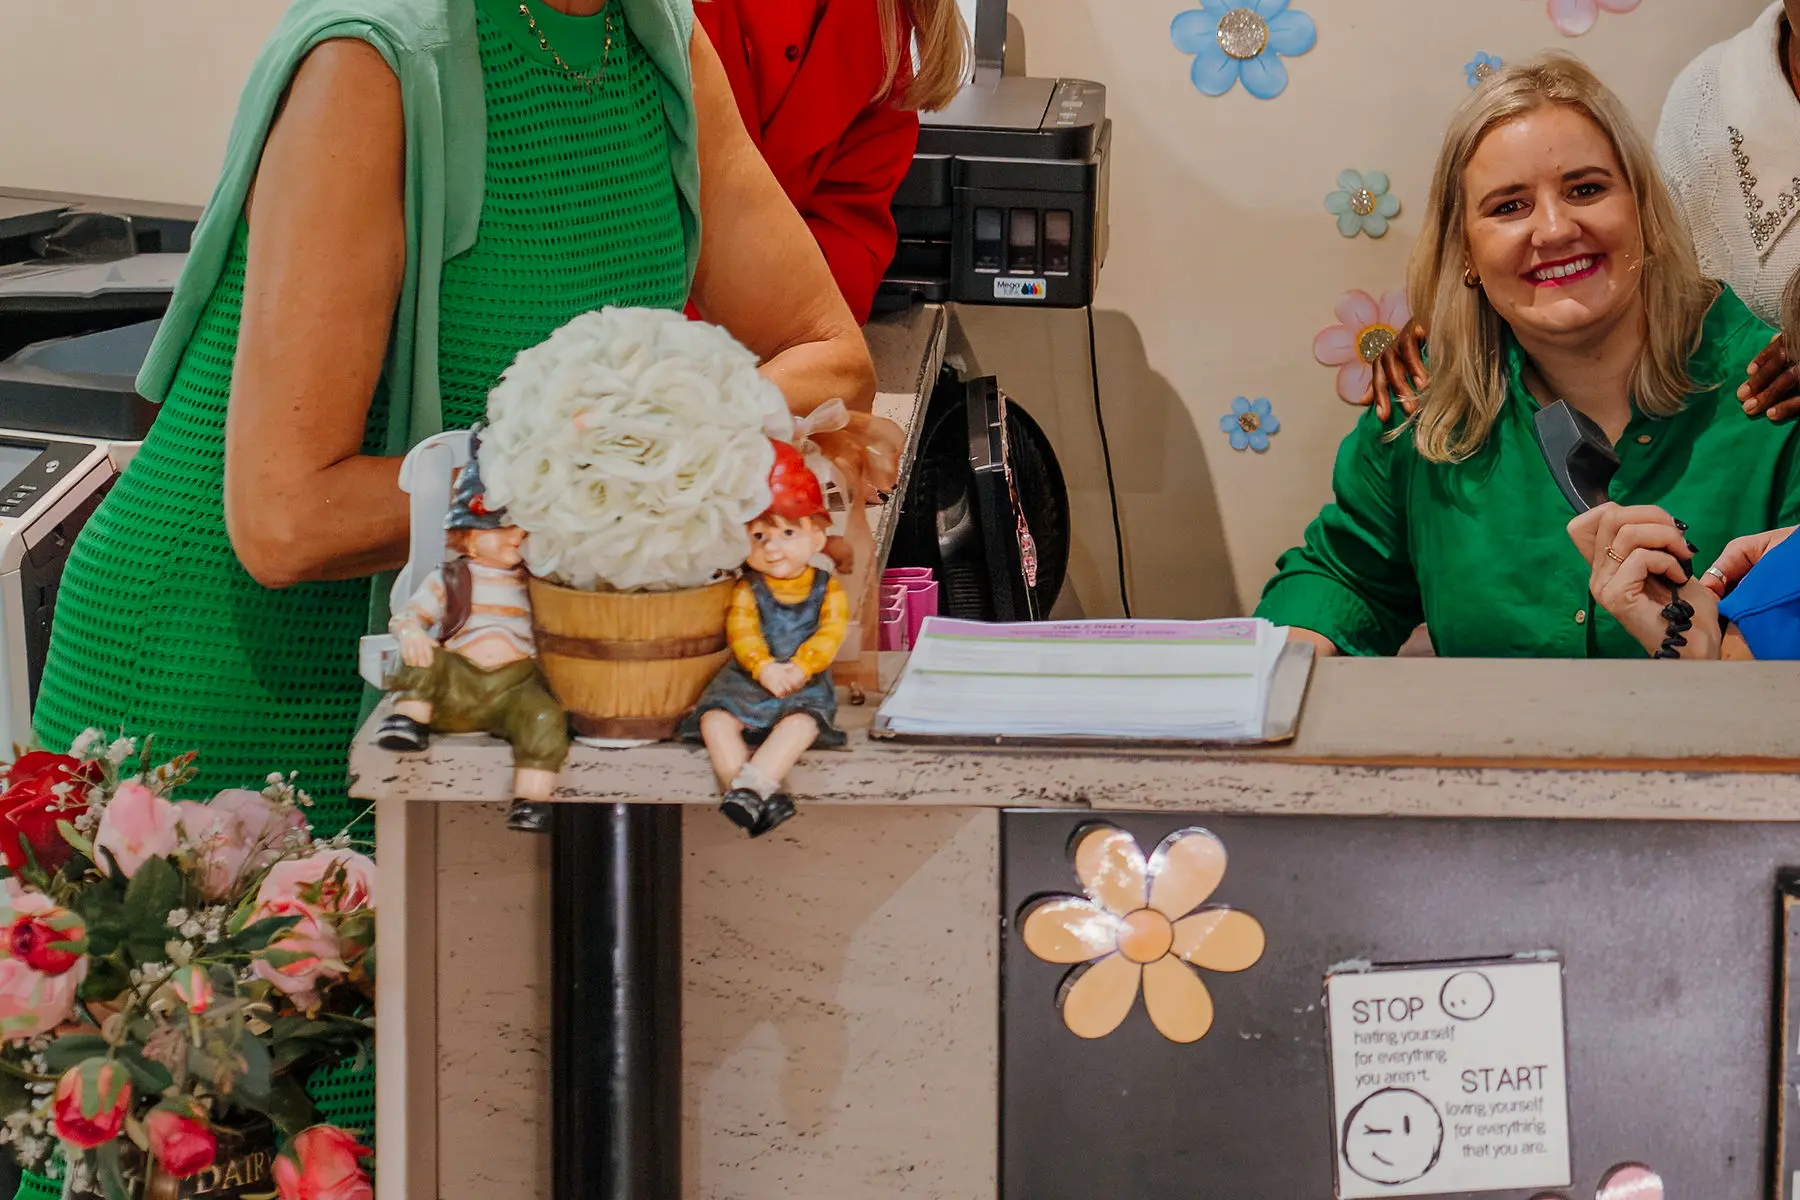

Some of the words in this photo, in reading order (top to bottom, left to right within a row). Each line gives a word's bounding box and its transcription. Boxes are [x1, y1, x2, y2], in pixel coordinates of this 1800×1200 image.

[1352, 997, 1424, 1024] STOP
[1354, 1029, 1398, 1045] hating
[1401, 1026, 1455, 1044] yourself
[1354, 1051, 1373, 1068] for
[1377, 1049, 1447, 1067] everything
[1355, 1073, 1381, 1088] you
[1461, 1065, 1548, 1094] START
[1446, 1101, 1486, 1118] loving
[1490, 1097, 1544, 1115] yourself
[1454, 1122, 1473, 1140] for
[1477, 1117, 1546, 1137] everything
[1463, 1143, 1489, 1158] that
[1493, 1141, 1517, 1159] you
